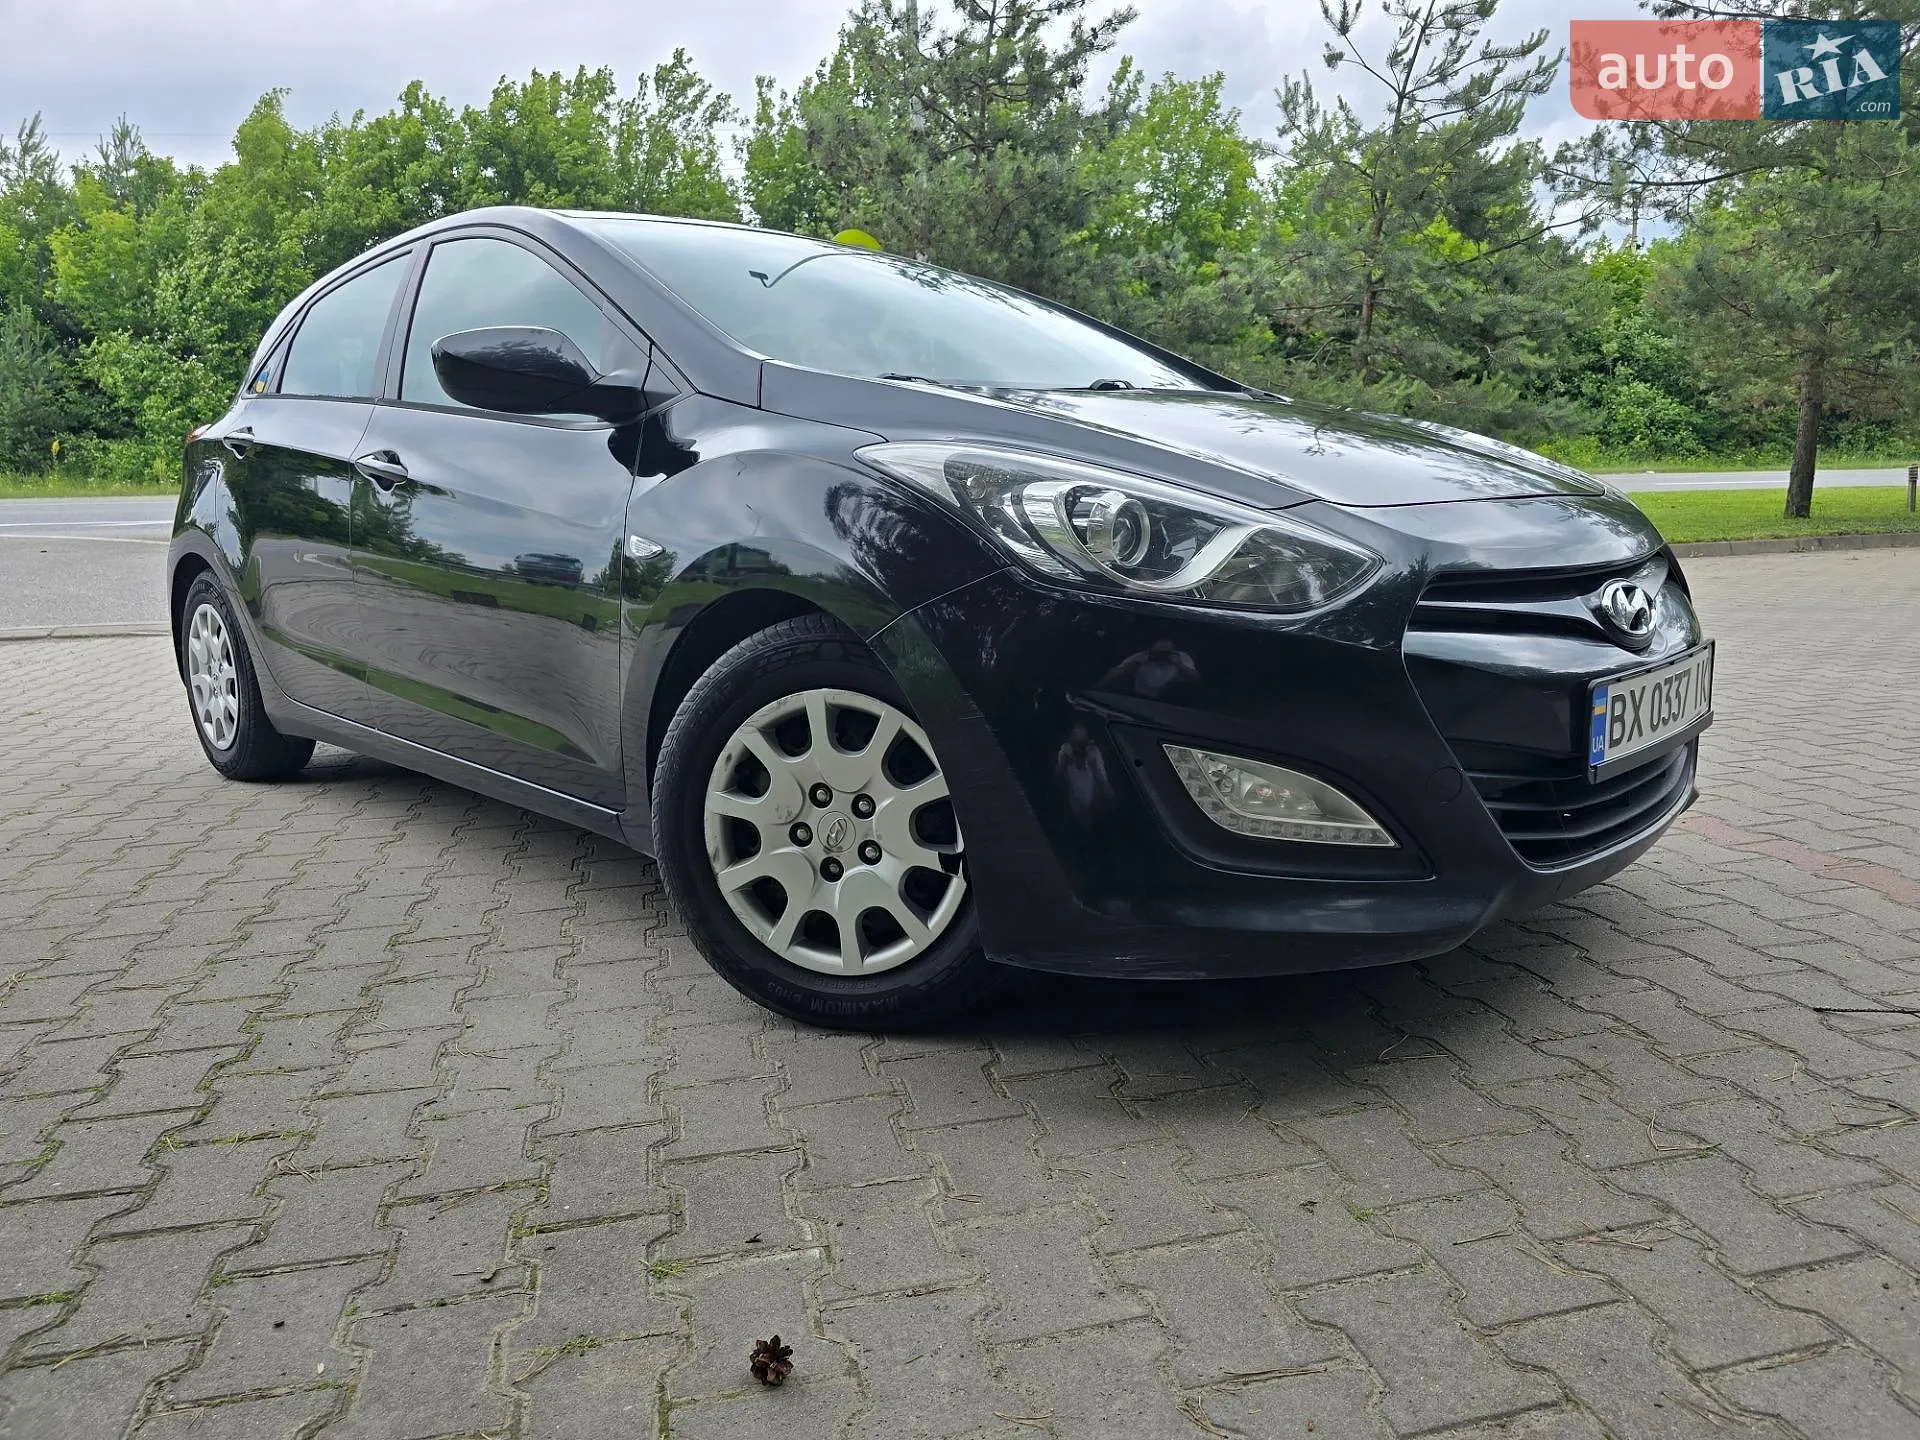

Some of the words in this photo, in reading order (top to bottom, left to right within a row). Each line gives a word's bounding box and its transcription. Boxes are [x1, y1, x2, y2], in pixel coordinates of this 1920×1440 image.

[1608, 685, 1647, 749] BX
[1650, 667, 1692, 733] 0337
[1694, 655, 1710, 710] IK
[1592, 735, 1604, 753] UA
[808, 994, 899, 1016] MAXIMUM
